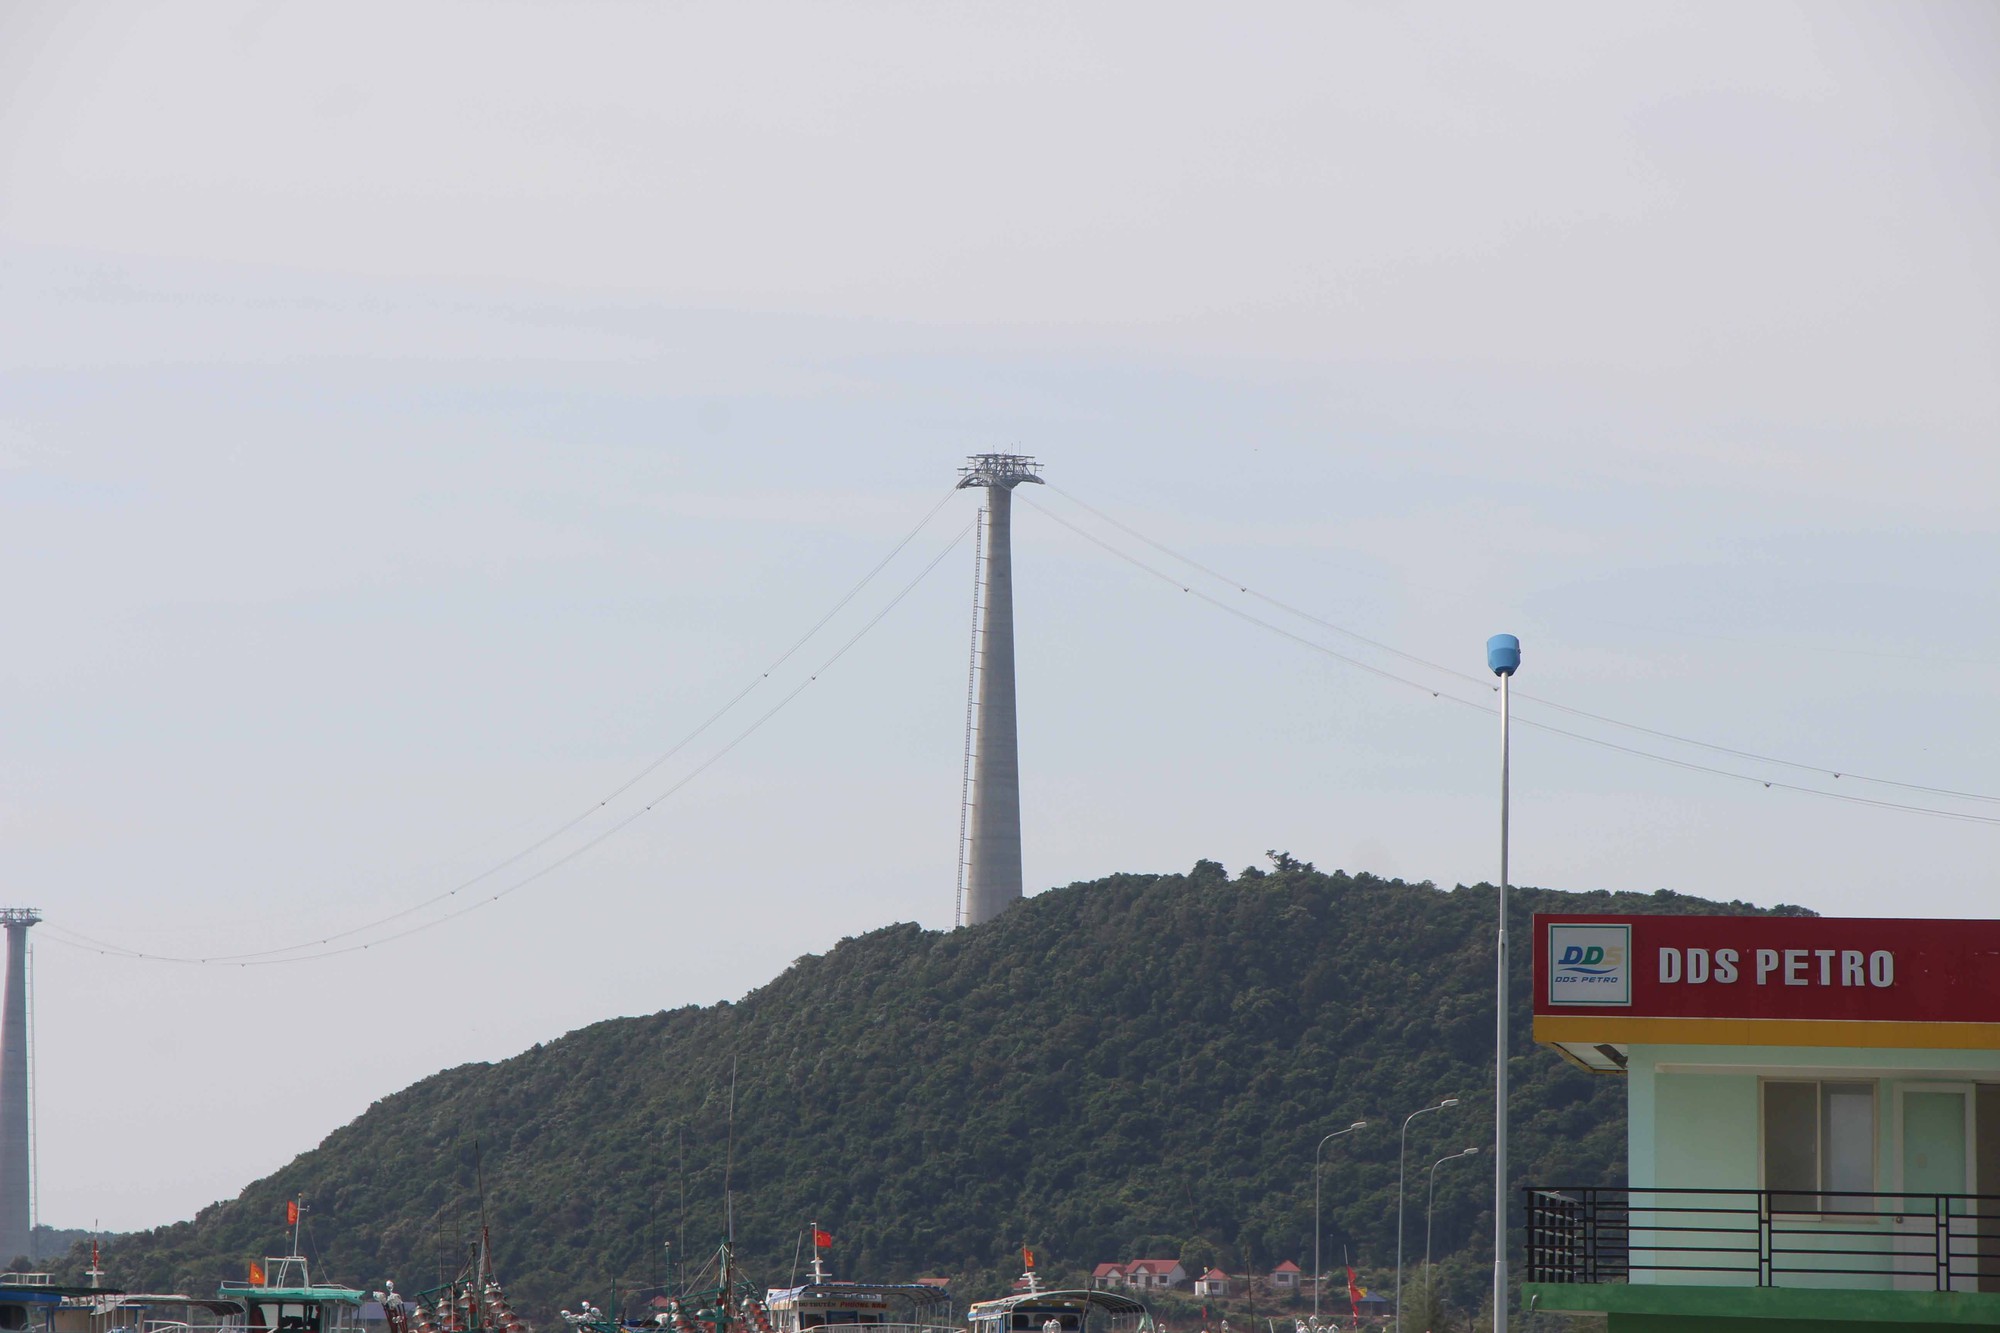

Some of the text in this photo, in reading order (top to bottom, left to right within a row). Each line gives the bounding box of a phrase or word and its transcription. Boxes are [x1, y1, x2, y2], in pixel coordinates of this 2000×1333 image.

[1558, 946, 1624, 965] DDS
[1659, 947, 1894, 987] DDS PETRO
